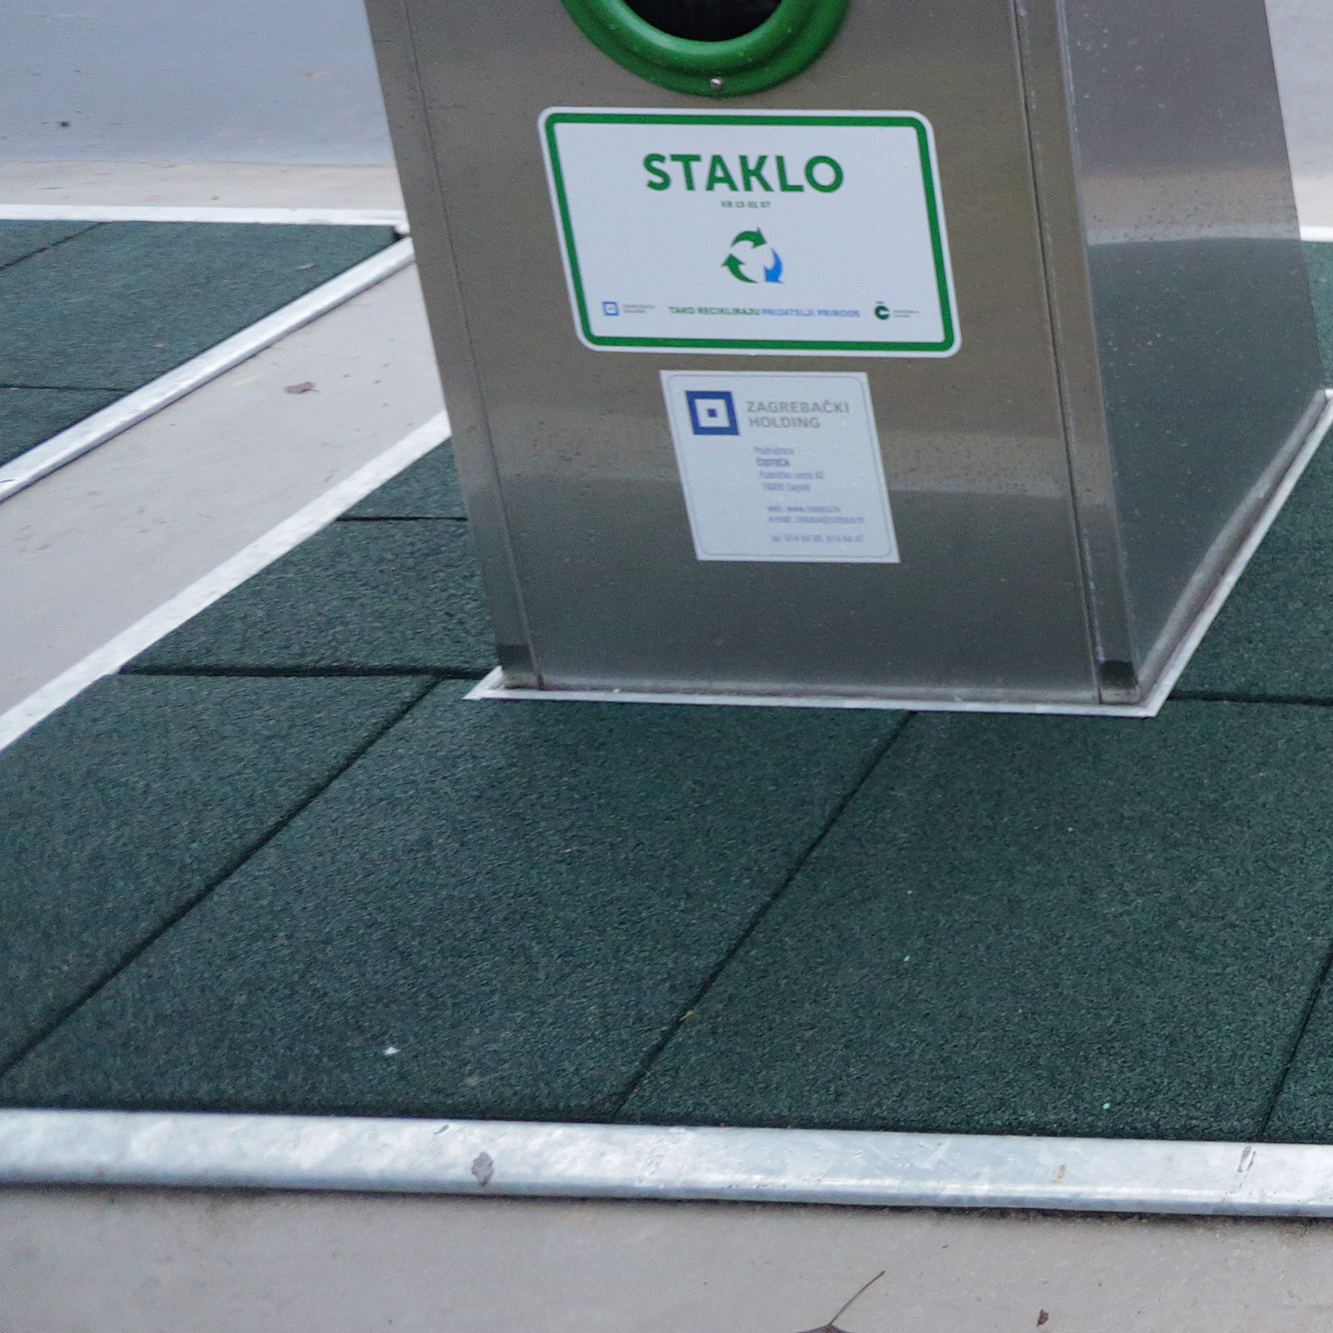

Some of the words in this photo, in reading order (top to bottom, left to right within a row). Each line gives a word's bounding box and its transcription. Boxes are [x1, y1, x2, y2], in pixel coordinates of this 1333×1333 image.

[642, 153, 844, 194] STAKLO
[746, 399, 850, 414] ZAGREBAČKI
[748, 416, 821, 428] HOLDING
